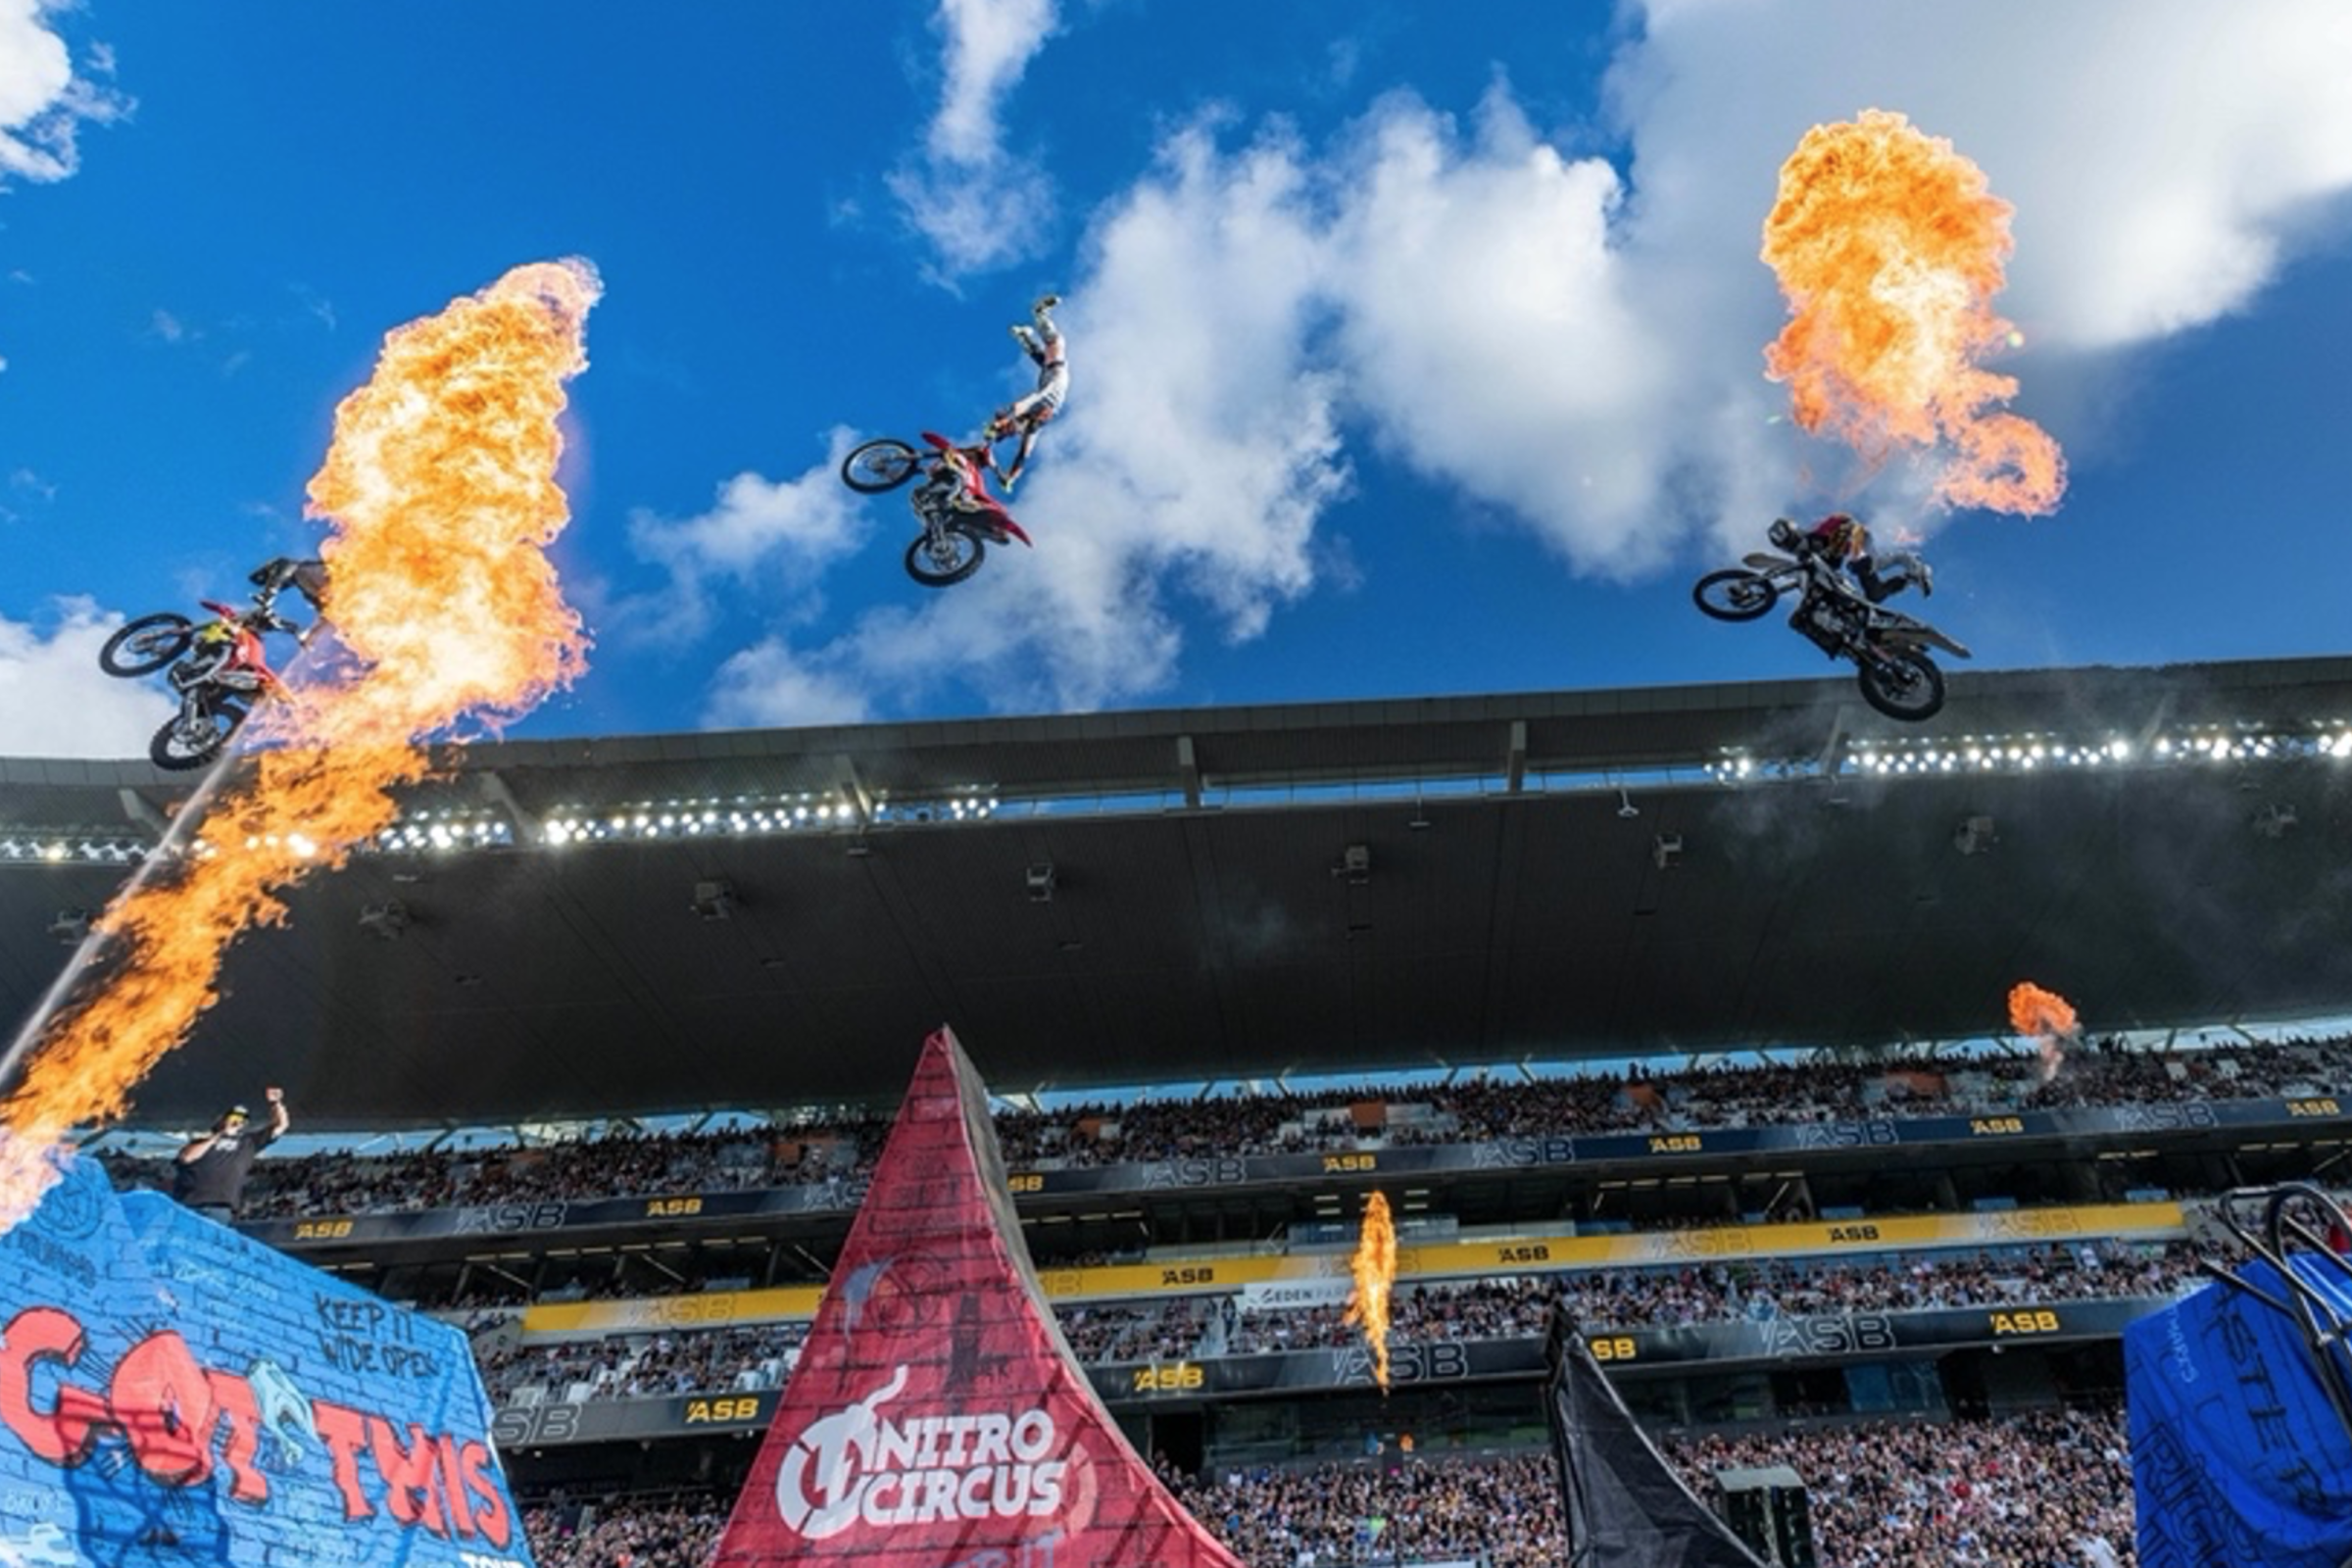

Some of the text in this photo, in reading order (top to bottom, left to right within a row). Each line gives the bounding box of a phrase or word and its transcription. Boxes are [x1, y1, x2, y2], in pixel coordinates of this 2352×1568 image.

[2284, 1099, 2340, 1117] ASB
[1971, 1117, 2024, 1134] ASB
[1648, 1135, 1702, 1153] ASB
[1323, 1154, 1377, 1173] ASB
[1006, 1174, 1044, 1192] SB
[647, 1198, 703, 1216] ASB
[294, 1219, 354, 1240] ASB
[1830, 1225, 1879, 1243] ASB
[1498, 1246, 1549, 1263] ASB
[1161, 1268, 1213, 1286] ASB
[1275, 1290, 1313, 1301] EDEN
[314, 1290, 385, 1336] KEEP
[1990, 1310, 2059, 1334] ASB
[1759, 1312, 1895, 1356] ASB
[316, 1328, 440, 1379] WIDE OPEN
[1591, 1337, 1638, 1359] SB
[1134, 1366, 1204, 1392] ASB
[686, 1397, 759, 1423] ASB
[493, 1402, 582, 1446] SB
[875, 1408, 1055, 1470] NITRO
[861, 1459, 1068, 1527] CIRCUS
